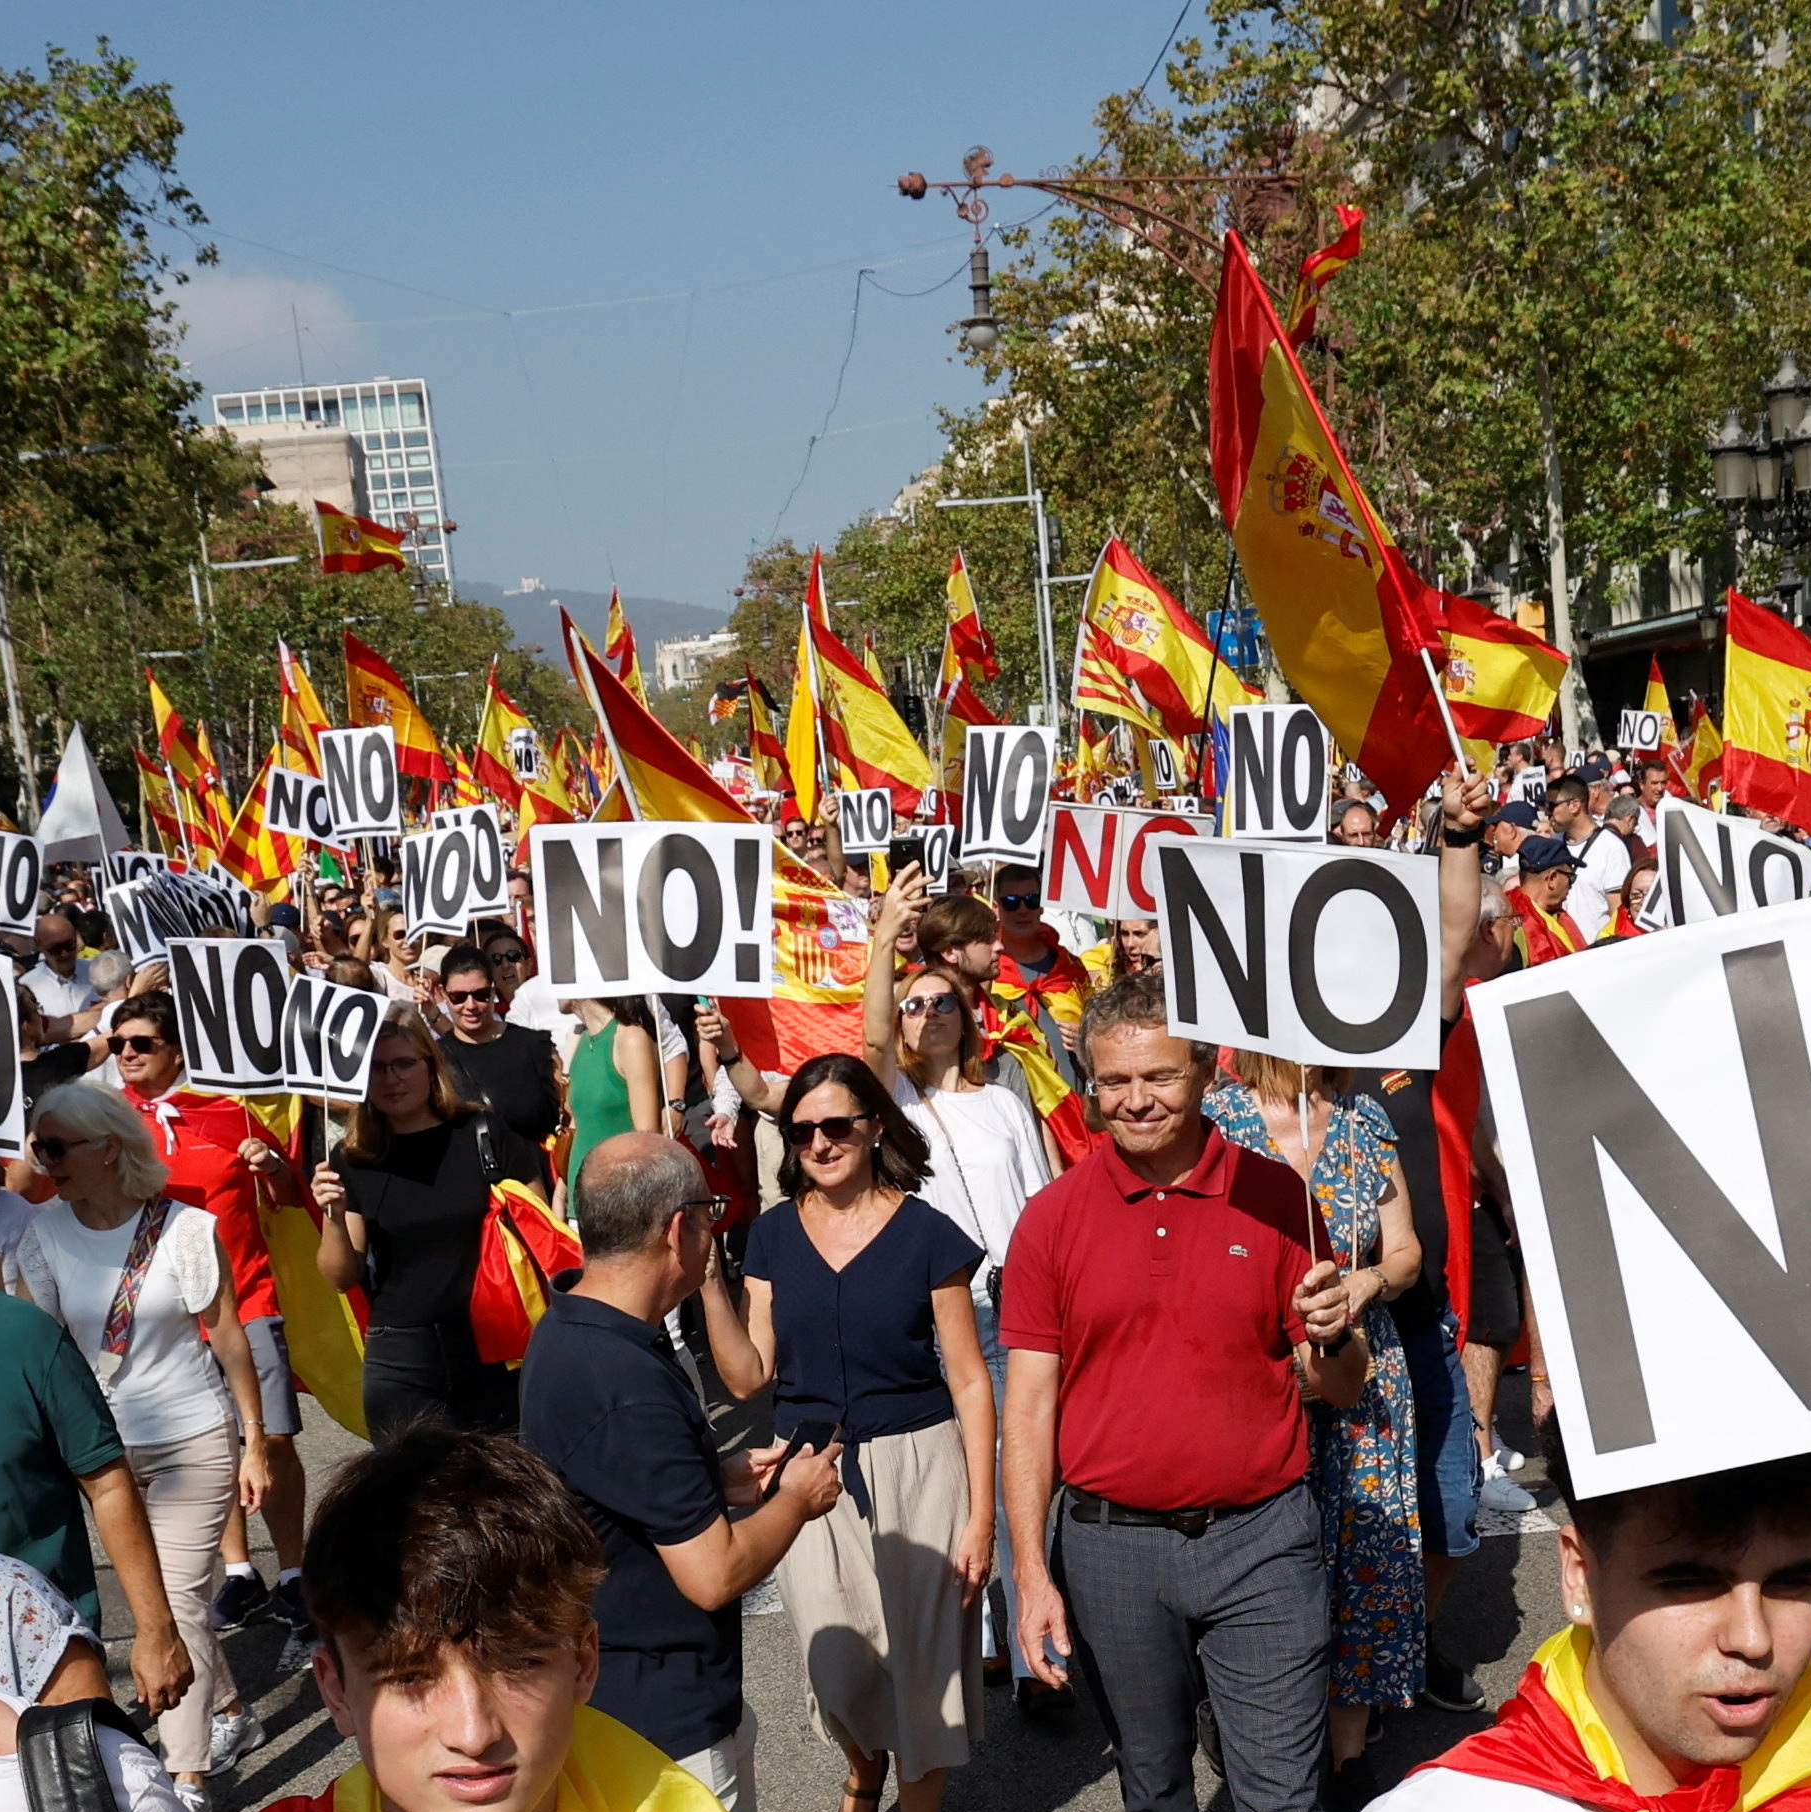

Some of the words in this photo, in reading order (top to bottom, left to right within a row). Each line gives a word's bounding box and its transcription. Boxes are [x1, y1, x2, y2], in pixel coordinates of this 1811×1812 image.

[323, 732, 395, 826] NO
[515, 748, 534, 773] NO
[1150, 742, 1172, 783] NO
[1234, 705, 1326, 831] NO
[1621, 712, 1658, 746] NO
[841, 791, 889, 843] NO
[965, 731, 1049, 846] NO
[405, 831, 472, 921] NO
[543, 834, 759, 984] NO!
[1665, 810, 1803, 926] NO
[1159, 846, 1429, 1055] NO
[171, 944, 289, 1075] NO
[287, 978, 379, 1083] NO
